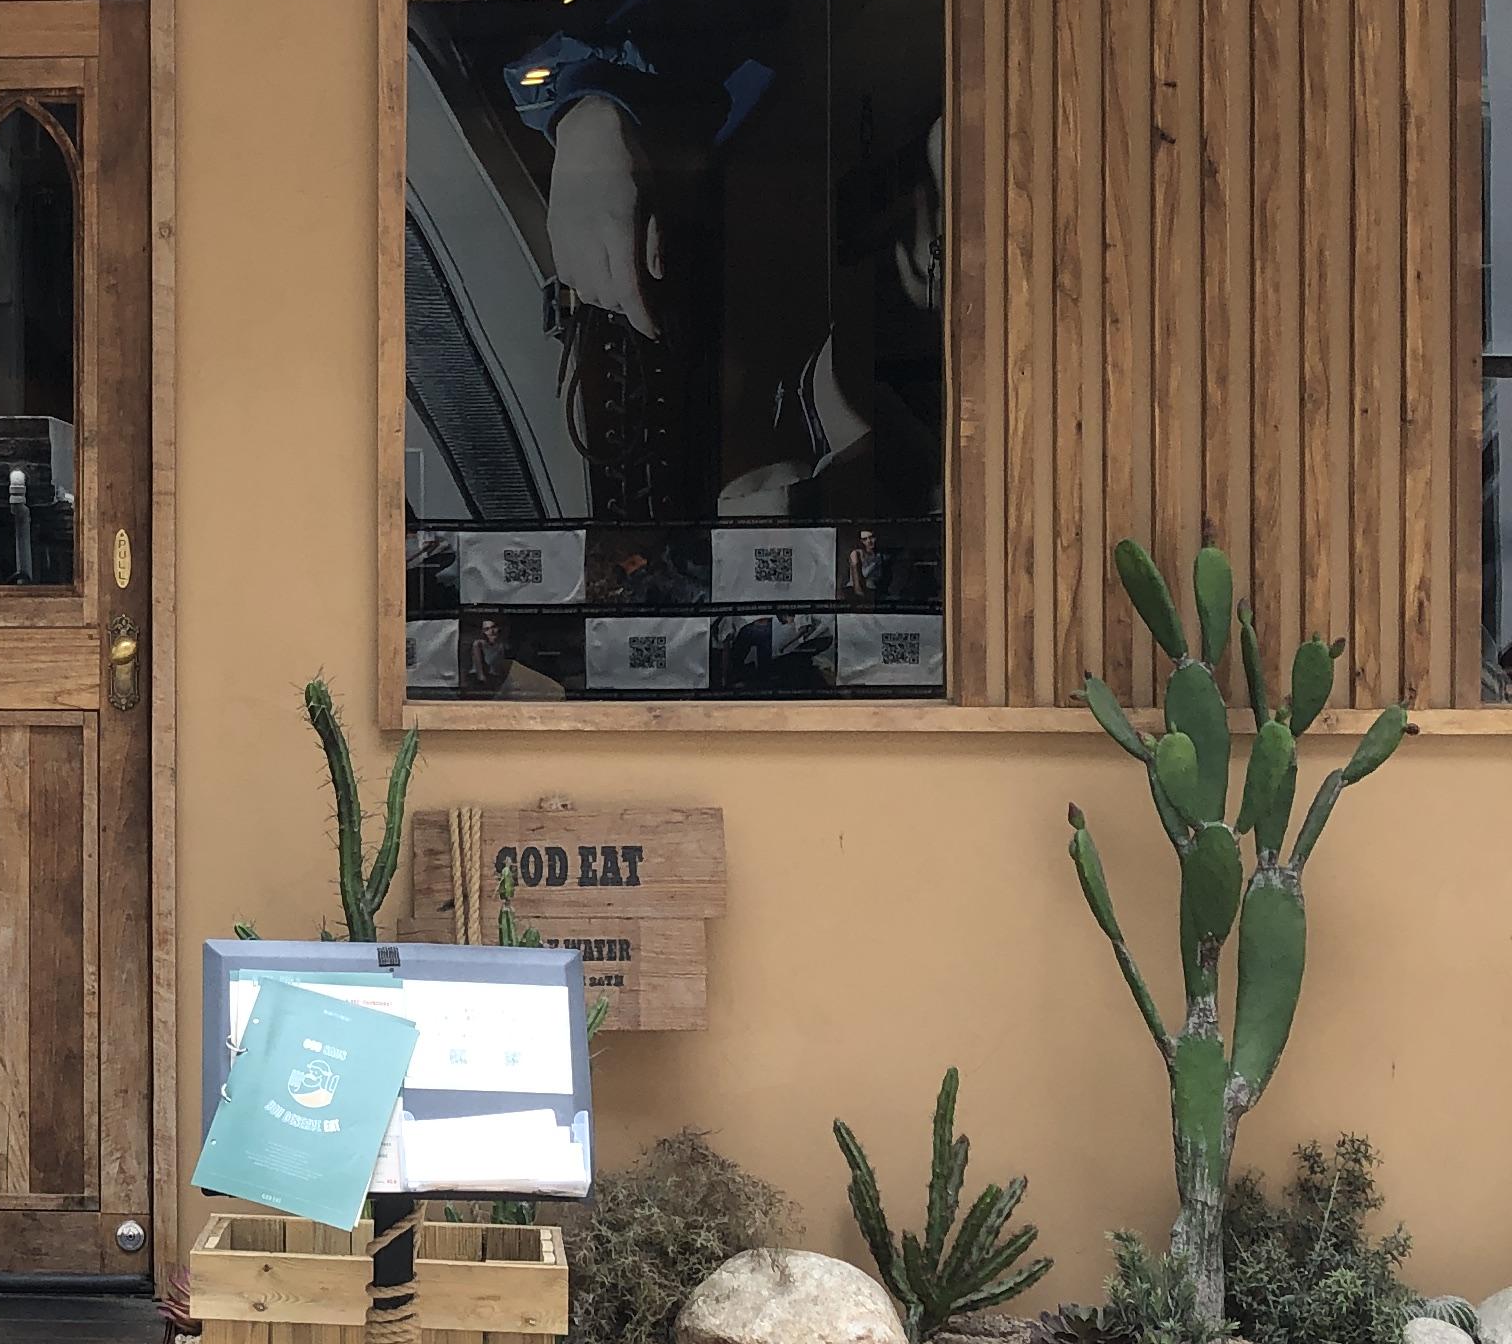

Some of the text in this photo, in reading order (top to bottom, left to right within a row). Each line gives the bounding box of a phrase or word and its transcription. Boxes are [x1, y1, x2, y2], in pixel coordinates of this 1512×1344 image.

[118, 539, 128, 580] PULL
[494, 845, 644, 887] GOD EAT
